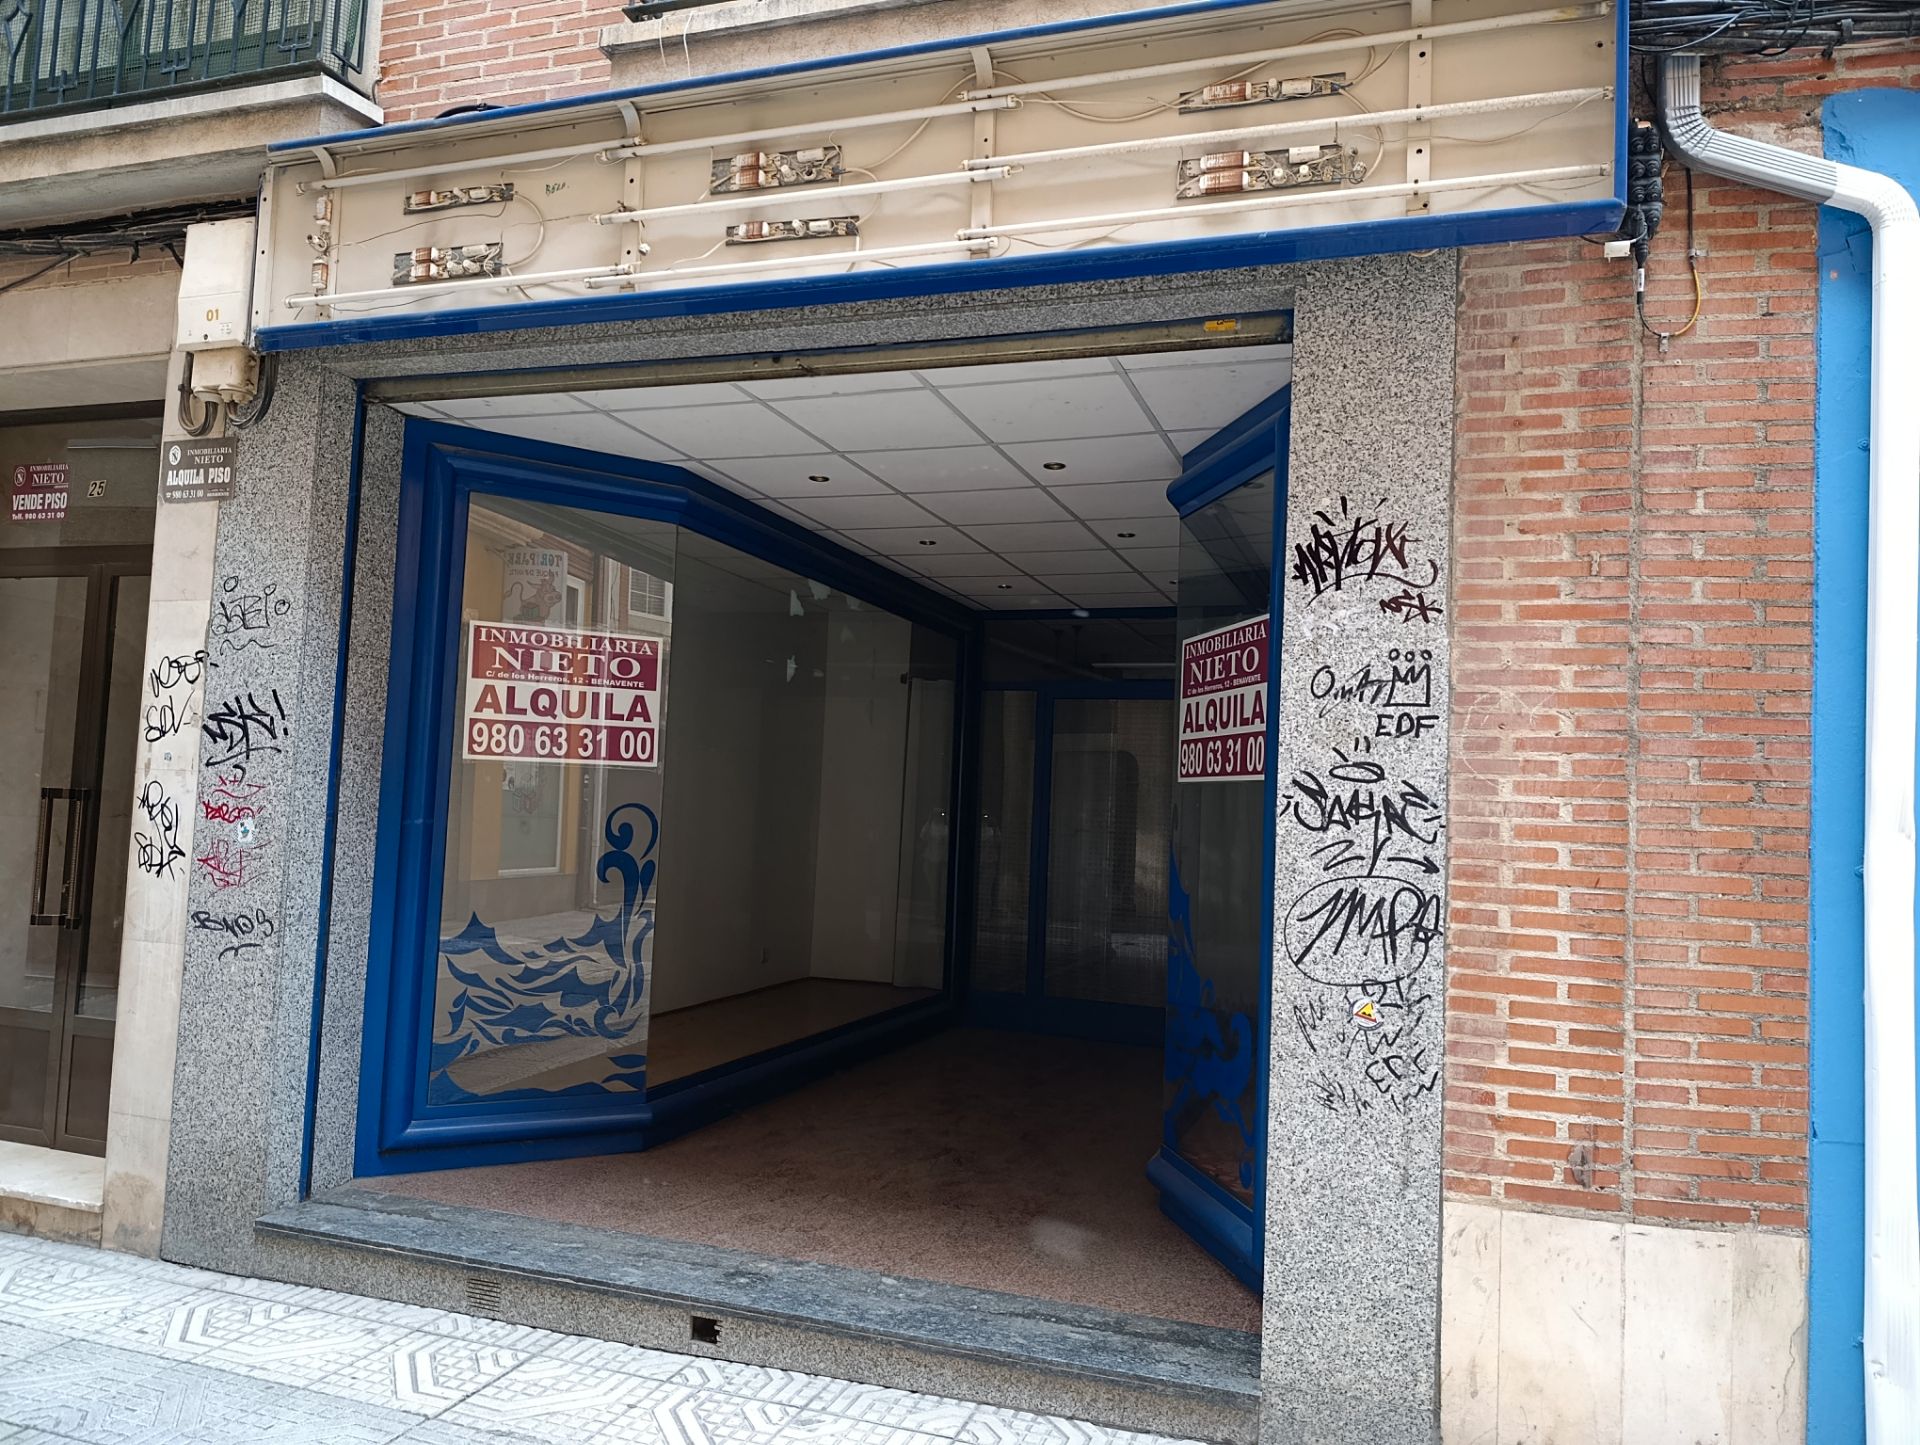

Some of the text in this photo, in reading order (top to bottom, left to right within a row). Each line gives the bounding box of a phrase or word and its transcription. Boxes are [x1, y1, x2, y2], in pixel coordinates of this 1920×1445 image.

[206, 308, 220, 322] 01
[187, 447, 233, 456] INMOBILIARIA
[194, 455, 224, 465] NIETO
[29, 463, 69, 472] INMOBILIARIA
[166, 467, 231, 487] ALQUILA PISO
[32, 472, 64, 484] NIETO
[88, 481, 105, 497] 25
[12, 492, 68, 511] VENDE PISO
[56, 511, 65, 519] 00
[479, 627, 653, 656] INMOBILIARIA
[1185, 623, 1267, 660] INMOBILIARIA
[491, 646, 641, 678] NIETO
[1189, 646, 1260, 686] NIETO
[511, 672, 526, 680] los
[573, 676, 584, 684] 12
[591, 678, 645, 688] BENAVENTE
[473, 684, 652, 723] ALQUILA
[1182, 690, 1266, 734] ALQUILA
[1375, 712, 1440, 738] EDF
[472, 722, 652, 760] 980 63 31 00
[1181, 735, 1265, 775] 980 63 31 00
